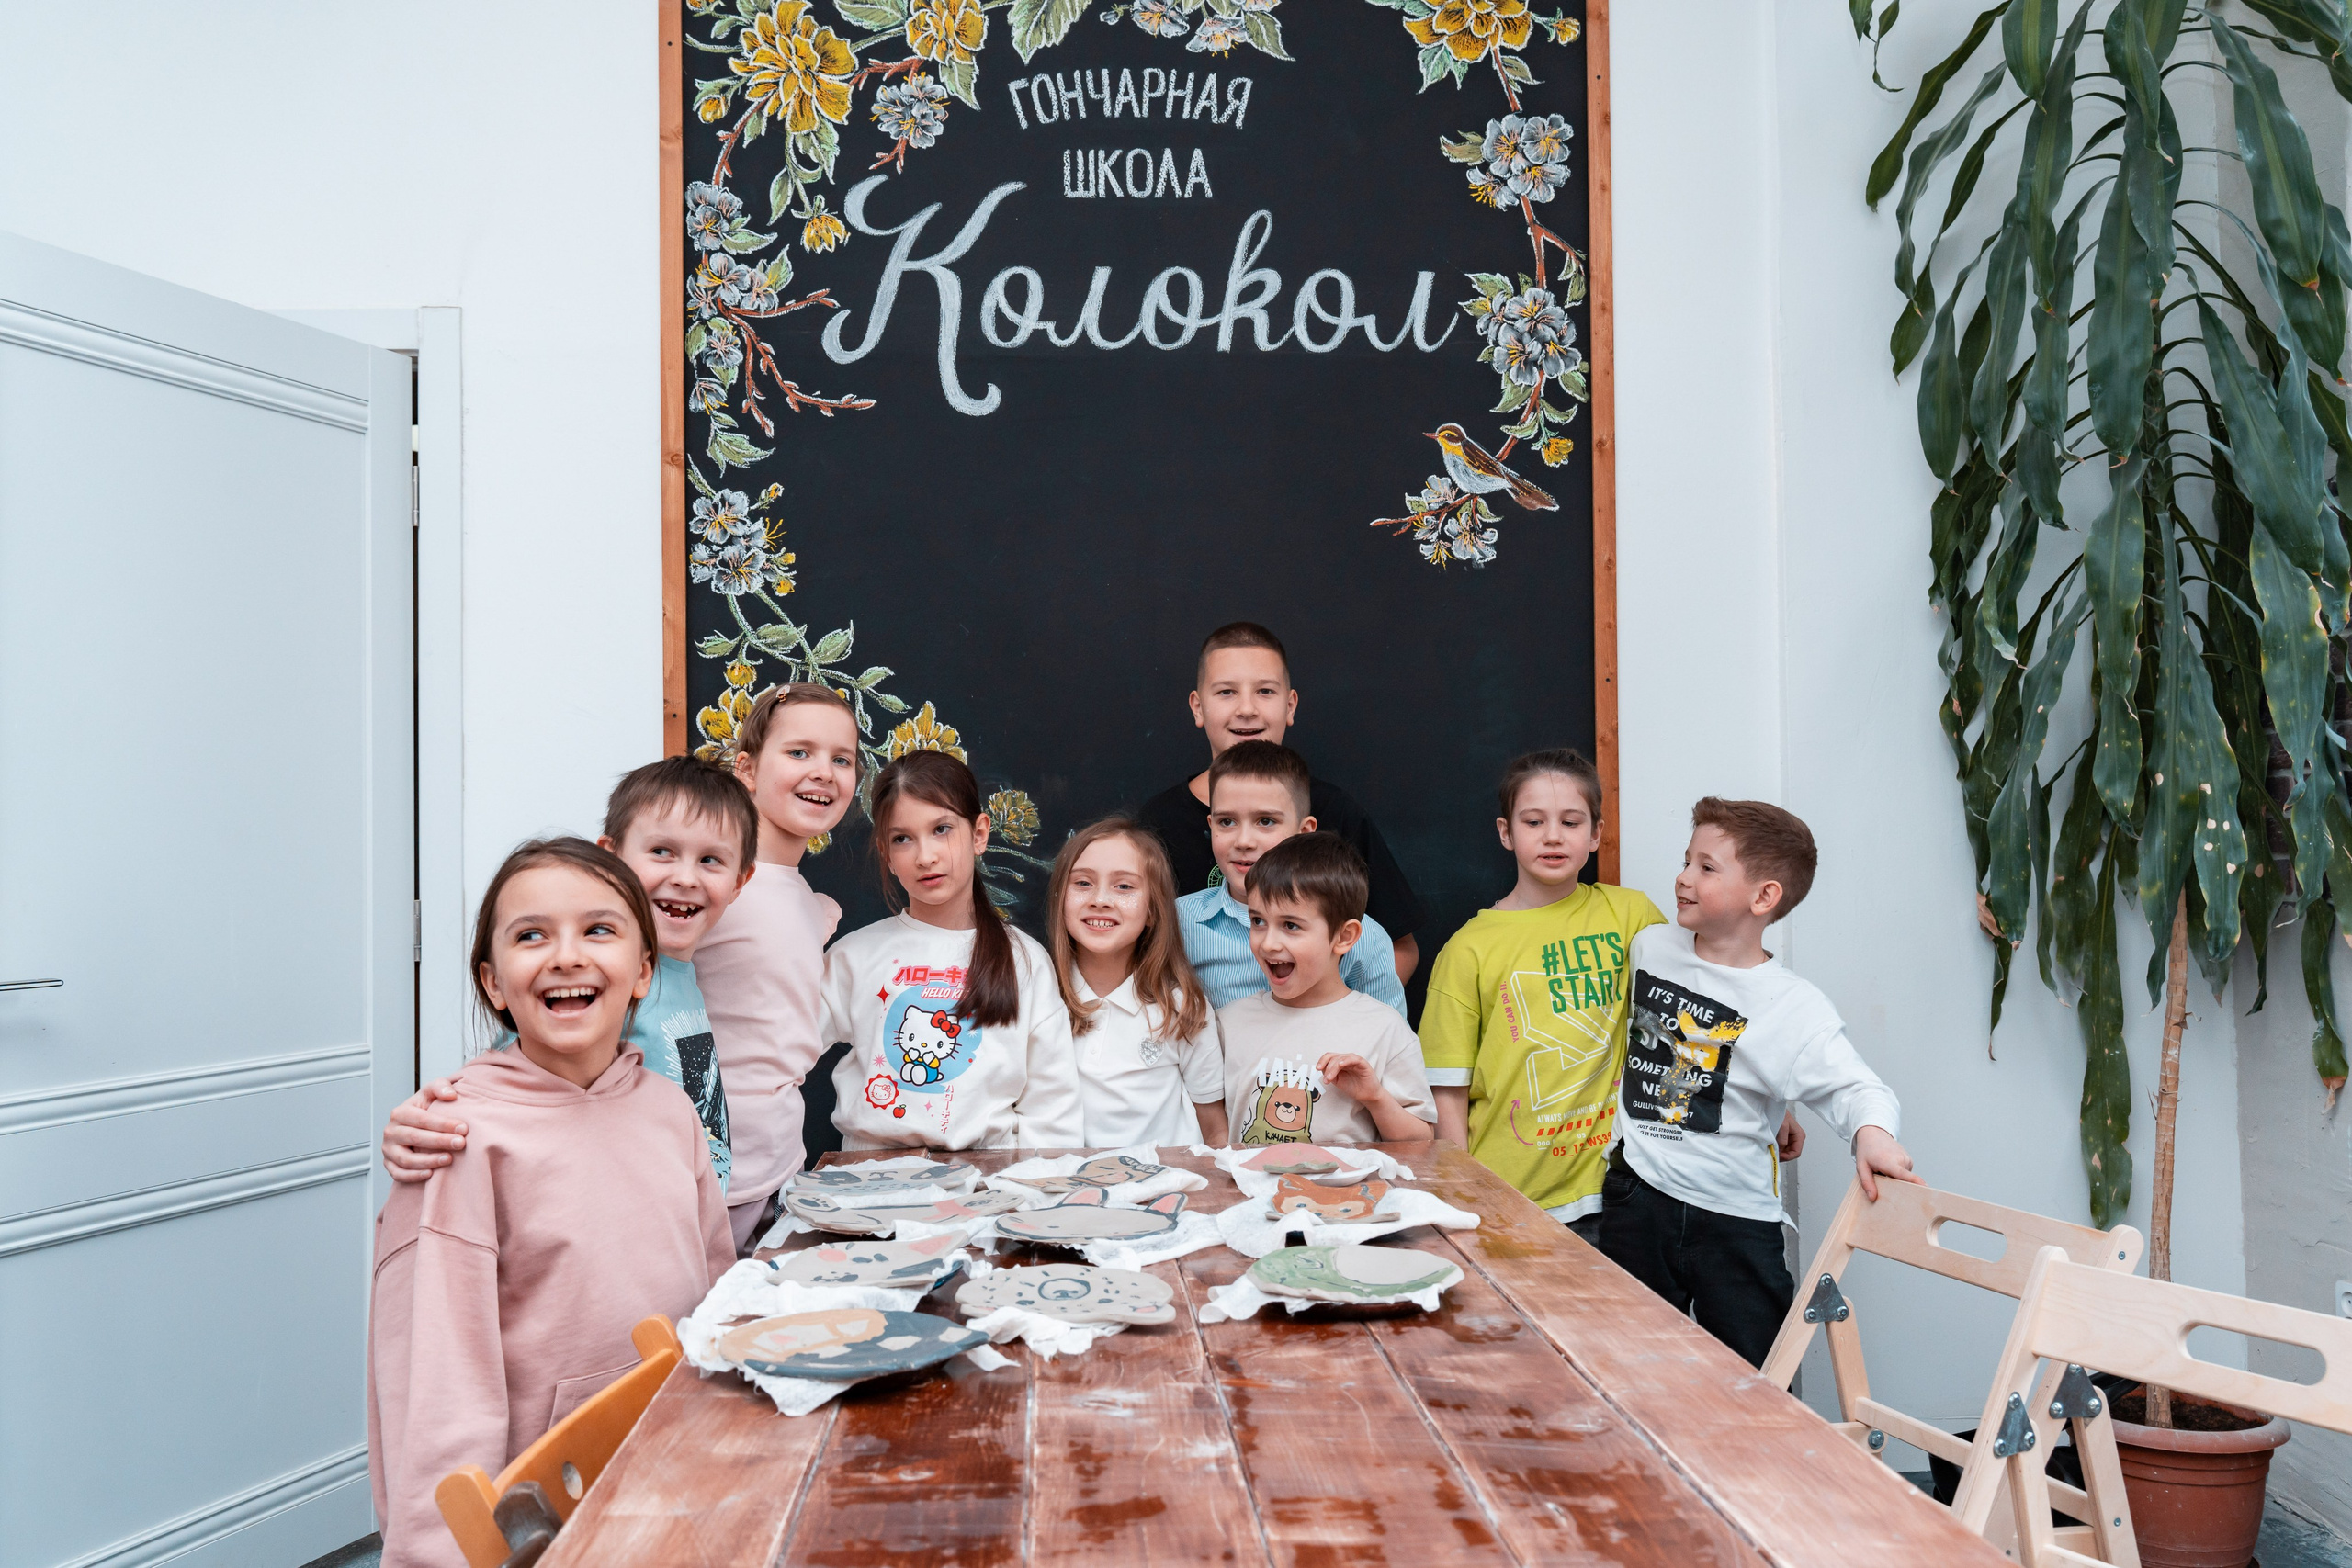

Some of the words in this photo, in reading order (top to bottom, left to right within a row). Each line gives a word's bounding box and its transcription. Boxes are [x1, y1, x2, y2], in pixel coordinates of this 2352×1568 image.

[1007, 67, 1253, 130] ГОНЧАРНАЯ
[1062, 147, 1214, 199] ШКОЛА
[821, 174, 1459, 417] Колокол
[1541, 932, 1624, 977] #LET'S
[892, 965, 969, 987] ハローキ
[921, 987, 951, 998] HELLO
[1501, 992, 1510, 1005] DO
[1548, 967, 1623, 1014] START
[1505, 1006, 1516, 1023] CAN
[1647, 986, 1675, 1004] IT'S
[1677, 997, 1715, 1024] TIME
[1659, 1012, 1679, 1031] TO
[1510, 1025, 1520, 1043] YOU
[1536, 1112, 1562, 1123] ALWAYS
[1577, 1105, 1588, 1115] AND
[1589, 1103, 1597, 1113] BE
[1265, 1130, 1297, 1143] КАЧАЕТ
[1658, 1127, 1683, 1135] STRONGER
